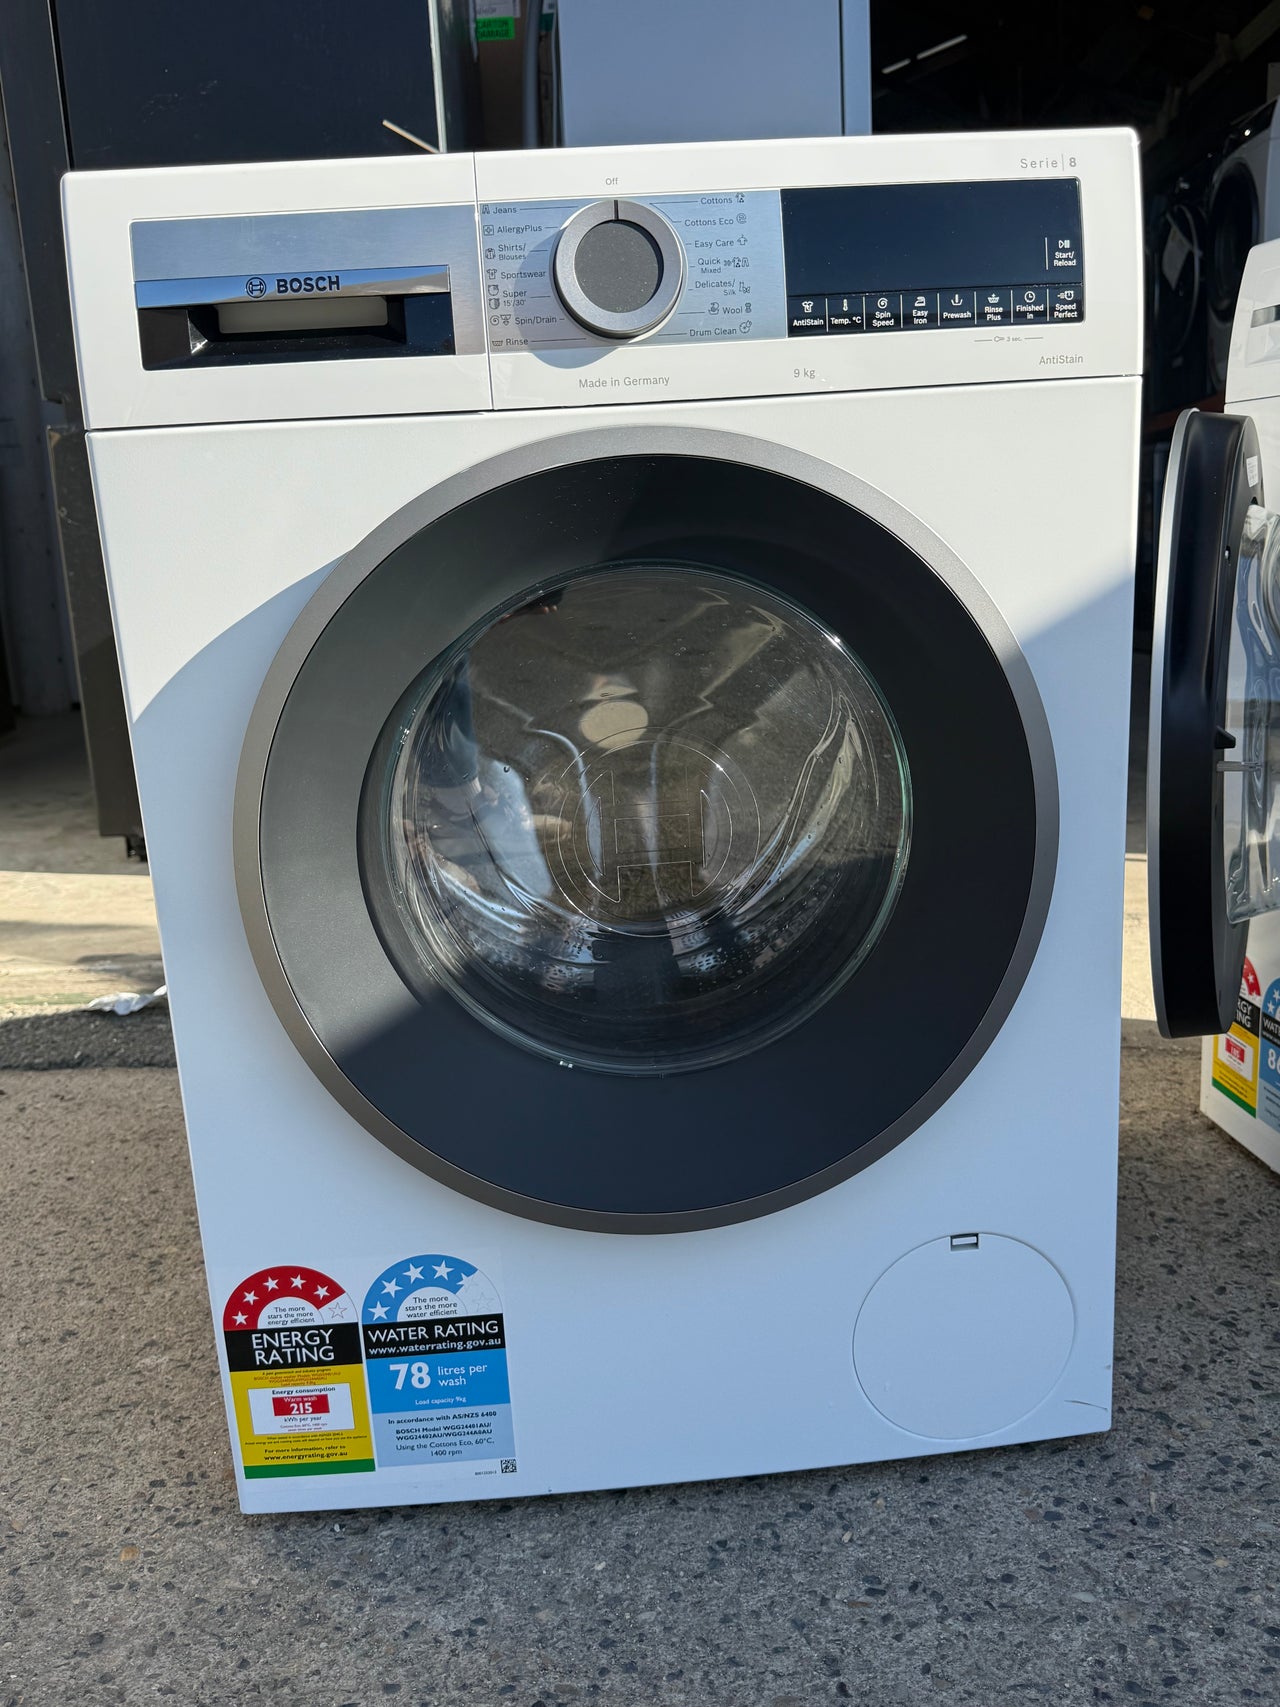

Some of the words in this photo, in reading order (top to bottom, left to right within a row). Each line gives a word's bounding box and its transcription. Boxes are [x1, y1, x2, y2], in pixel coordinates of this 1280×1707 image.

[1020, 157, 1058, 169] Serie
[1069, 157, 1077, 167] 8
[605, 177, 618, 185] Off
[700, 197, 733, 205] Cottons
[492, 206, 517, 215] Jeans
[684, 219, 717, 227] Cottons
[718, 217, 734, 226] Eco
[497, 224, 543, 234] AllergyPlus
[498, 242, 527, 252] Shirts/
[694, 240, 713, 249] Easy
[715, 239, 735, 247] Care
[498, 253, 527, 261] Blouses
[1055, 251, 1075, 259] Start/
[697, 257, 721, 266] Quick
[1053, 258, 1077, 267] Reload
[500, 271, 546, 280] Sportswear
[276, 275, 340, 294] BOSCH
[695, 279, 736, 289] Delicates/
[502, 290, 528, 299] Super
[722, 306, 743, 314] Wool
[1016, 304, 1044, 312] Finished
[1055, 302, 1077, 311] Speed
[875, 311, 891, 319] Spin
[912, 309, 928, 318] Easy
[943, 311, 972, 319] Prewash
[986, 313, 1002, 321] Plus
[1026, 312, 1034, 320] in
[1054, 310, 1078, 319] Perfect
[515, 316, 557, 326] Spin/Drain
[793, 318, 824, 327] AntiStain
[830, 317, 851, 326] Temp.
[872, 318, 894, 328] Speed
[913, 317, 927, 325] Iron
[689, 329, 712, 337] Drum
[714, 327, 737, 336] Clean
[505, 338, 529, 346] Rinse
[1039, 354, 1084, 365] AntiStain
[793, 368, 800, 378] 9
[803, 367, 816, 379] kg
[578, 378, 607, 388] Made
[610, 377, 620, 387] in
[623, 376, 670, 386] Germany
[413, 1296, 427, 1304] The
[267, 1312, 283, 1320] stars
[406, 1311, 427, 1319] water
[429, 1308, 458, 1317] efficient
[267, 1318, 288, 1326] energy
[367, 1326, 429, 1343] WATER
[434, 1320, 499, 1338] RATING
[251, 1328, 334, 1349] ENERGY
[369, 1337, 502, 1355] www.waterrating.gov.au
[254, 1345, 335, 1366] RATING
[437, 1365, 466, 1376] litres
[469, 1364, 488, 1376] per
[389, 1361, 431, 1391] 78
[438, 1376, 467, 1387] wash
[272, 1388, 294, 1396] Energy
[295, 1386, 336, 1395] consumption
[289, 1402, 313, 1415] 215
[396, 1416, 434, 1424] accordance
[395, 1427, 421, 1435] BOSCH
[422, 1425, 441, 1433] Model
[429, 1441, 458, 1449] Cottons
[448, 1449, 463, 1457] rpm
